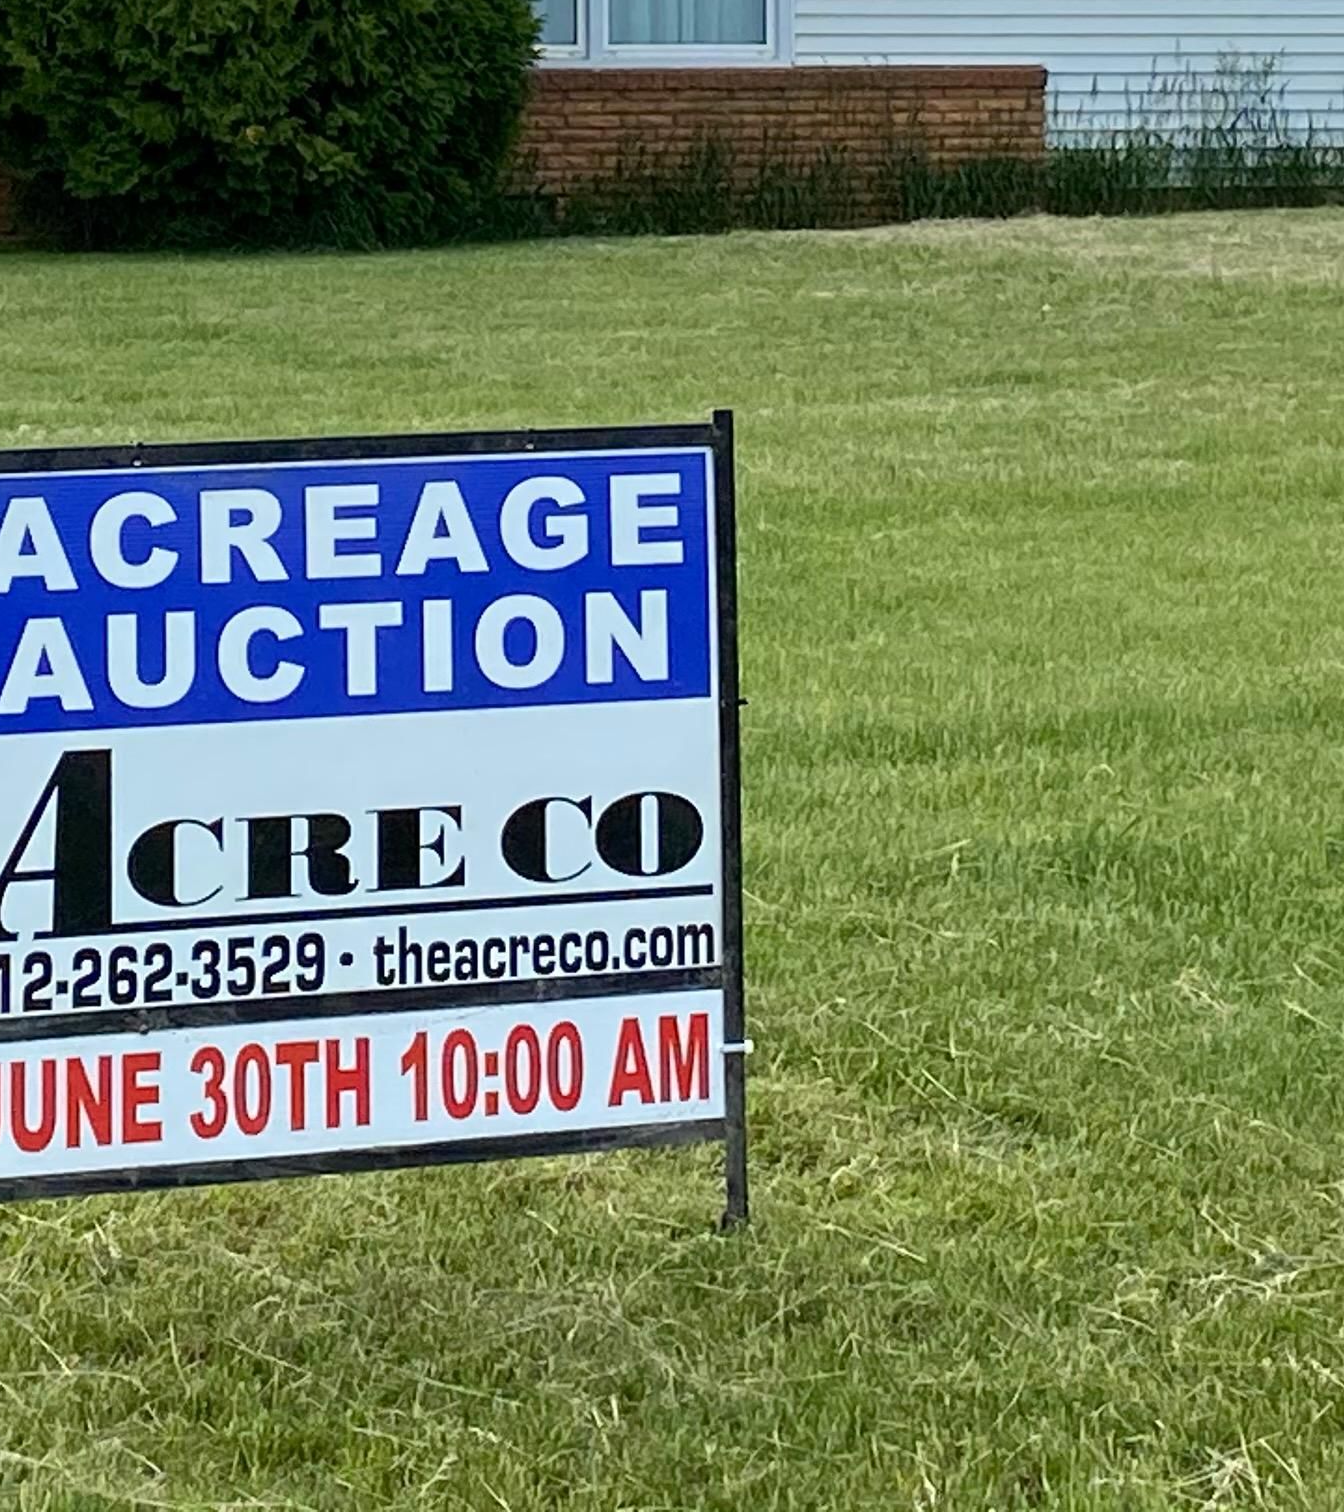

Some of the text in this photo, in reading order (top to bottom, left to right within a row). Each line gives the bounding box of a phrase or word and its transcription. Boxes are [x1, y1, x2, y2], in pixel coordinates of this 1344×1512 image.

[500, 790, 705, 884] CO
[372, 922, 716, 991] theacreco.com
[189, 1035, 372, 1139] 30TH
[400, 1019, 585, 1120] 10:00
[607, 1011, 711, 1107] AM
